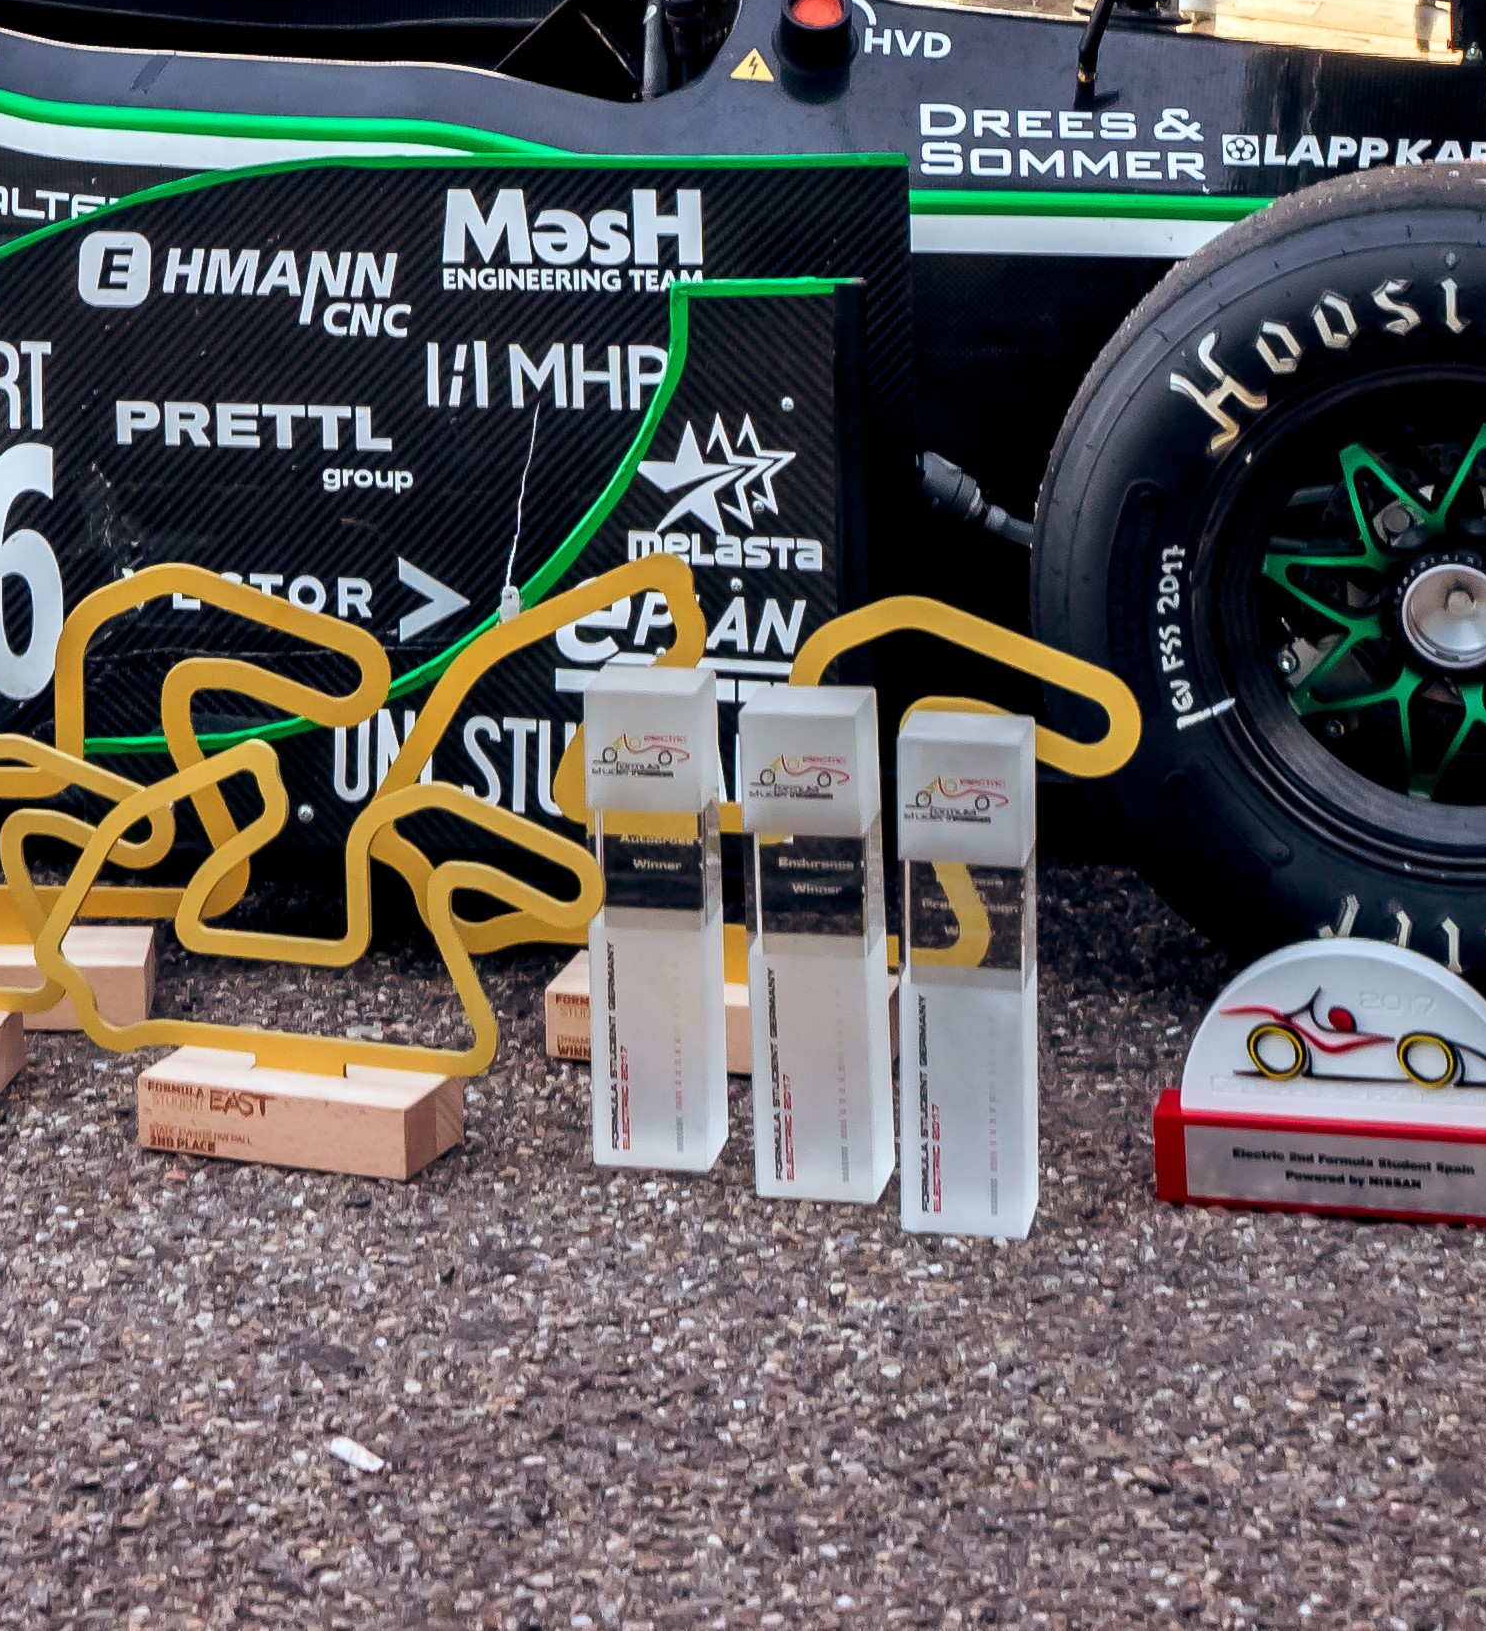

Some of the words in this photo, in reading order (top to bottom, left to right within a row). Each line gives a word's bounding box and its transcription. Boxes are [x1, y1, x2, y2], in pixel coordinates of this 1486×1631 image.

[863, 27, 952, 59] HVD
[1151, 107, 1205, 143] &
[919, 142, 1207, 181] SOMMER
[442, 267, 622, 292] ENGINEERING
[629, 269, 703, 292] TEAM
[323, 304, 411, 338] CNC
[508, 342, 668, 411] MHP
[115, 400, 392, 452] PRETTL
[321, 465, 414, 493] group
[1156, 544, 1187, 615] 2017
[555, 993, 590, 1008] FORM
[209, 1089, 277, 1118] EAST
[1285, 1169, 1345, 1185] Powered
[1318, 1153, 1374, 1168] Formula
[1378, 1156, 1432, 1171] Student
[1435, 1161, 1475, 1176] Spain
